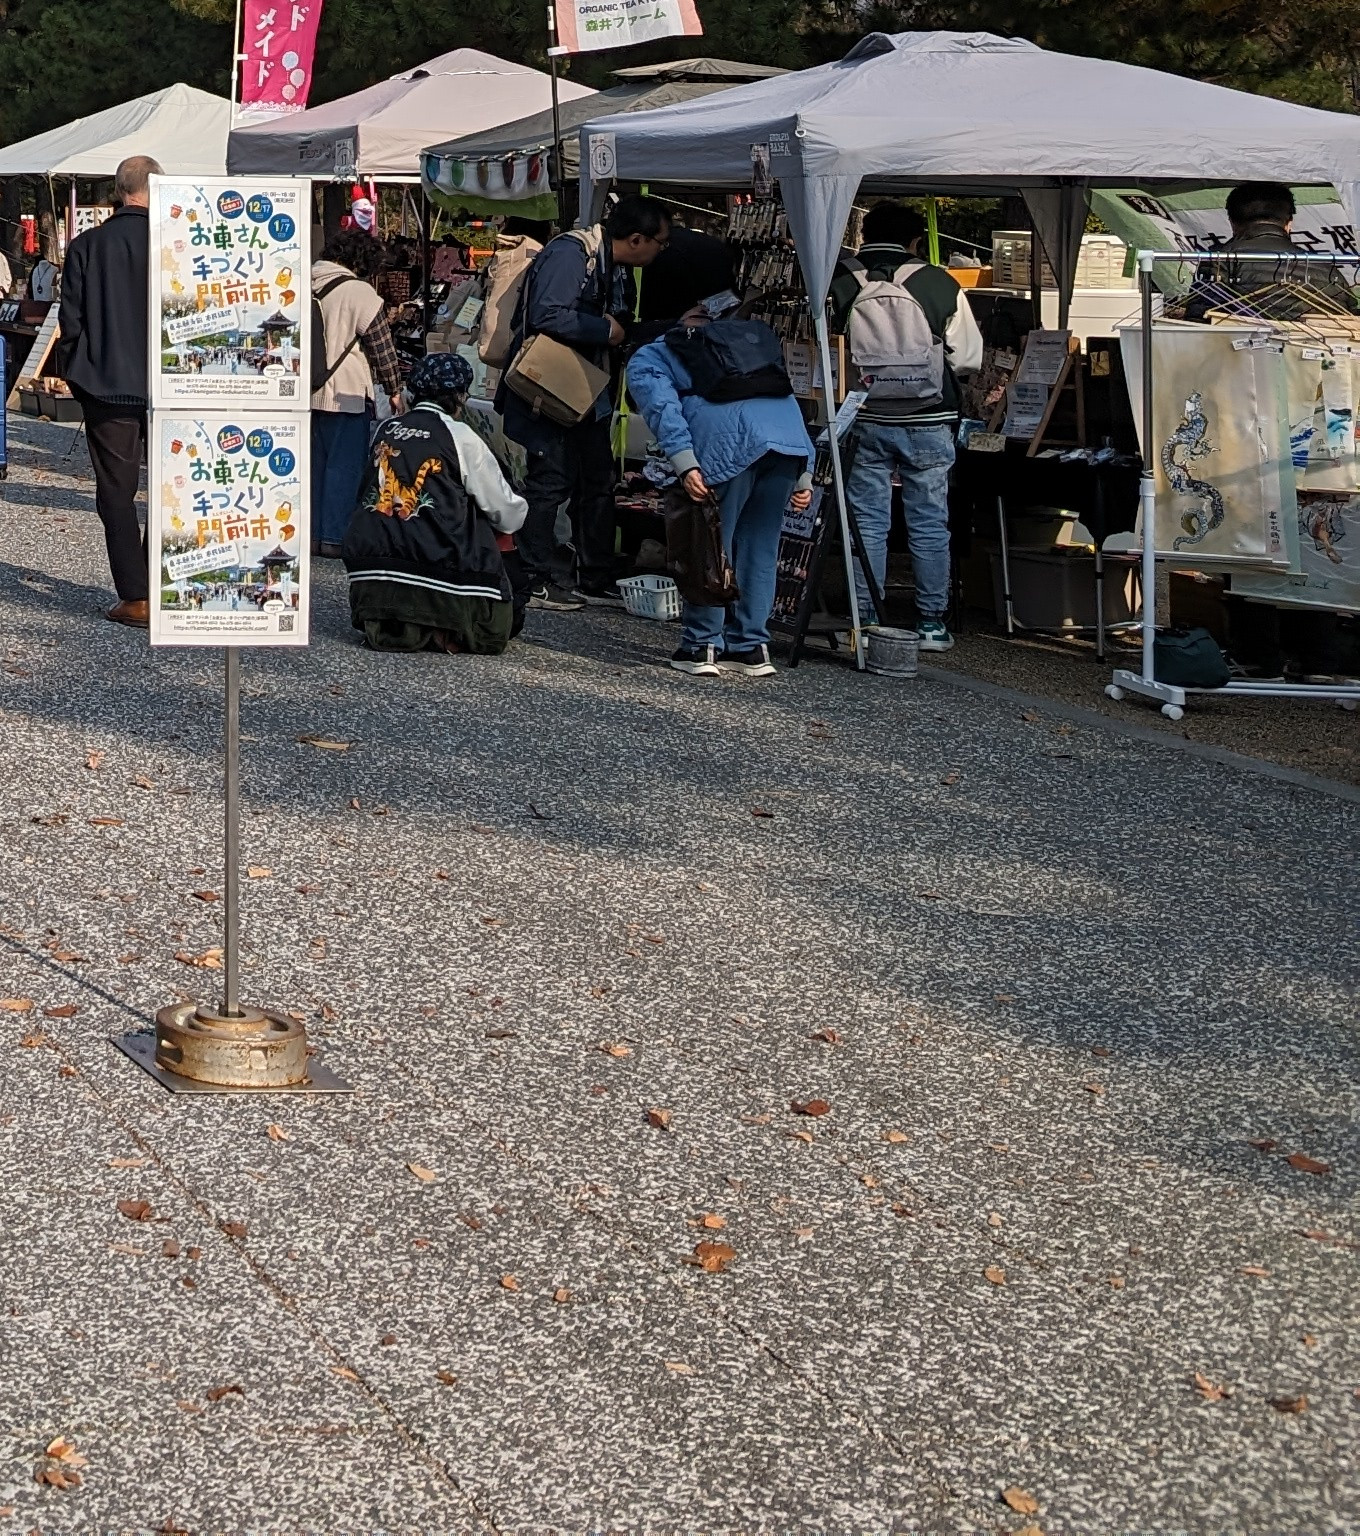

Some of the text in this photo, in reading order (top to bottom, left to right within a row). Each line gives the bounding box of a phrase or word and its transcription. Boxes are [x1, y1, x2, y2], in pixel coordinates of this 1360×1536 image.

[578, 4, 618, 14] ORGANIC
[620, 0, 637, 10] TEA
[585, 8, 667, 32] 森井ファーム
[254, 8, 278, 87] メイド
[249, 201, 270, 214] 12/17
[189, 222, 269, 251] お東さん
[274, 220, 290, 232] 1/7
[192, 251, 264, 281] 手づくり
[196, 278, 272, 310] 門前市
[864, 375, 929, 386] Champion
[249, 435, 271, 448] 12/17
[384, 421, 431, 441] Tigger
[189, 457, 269, 485] お東さん
[274, 455, 290, 467] 1/7
[192, 485, 264, 517] 手づくり
[196, 513, 272, 548] 門前市
